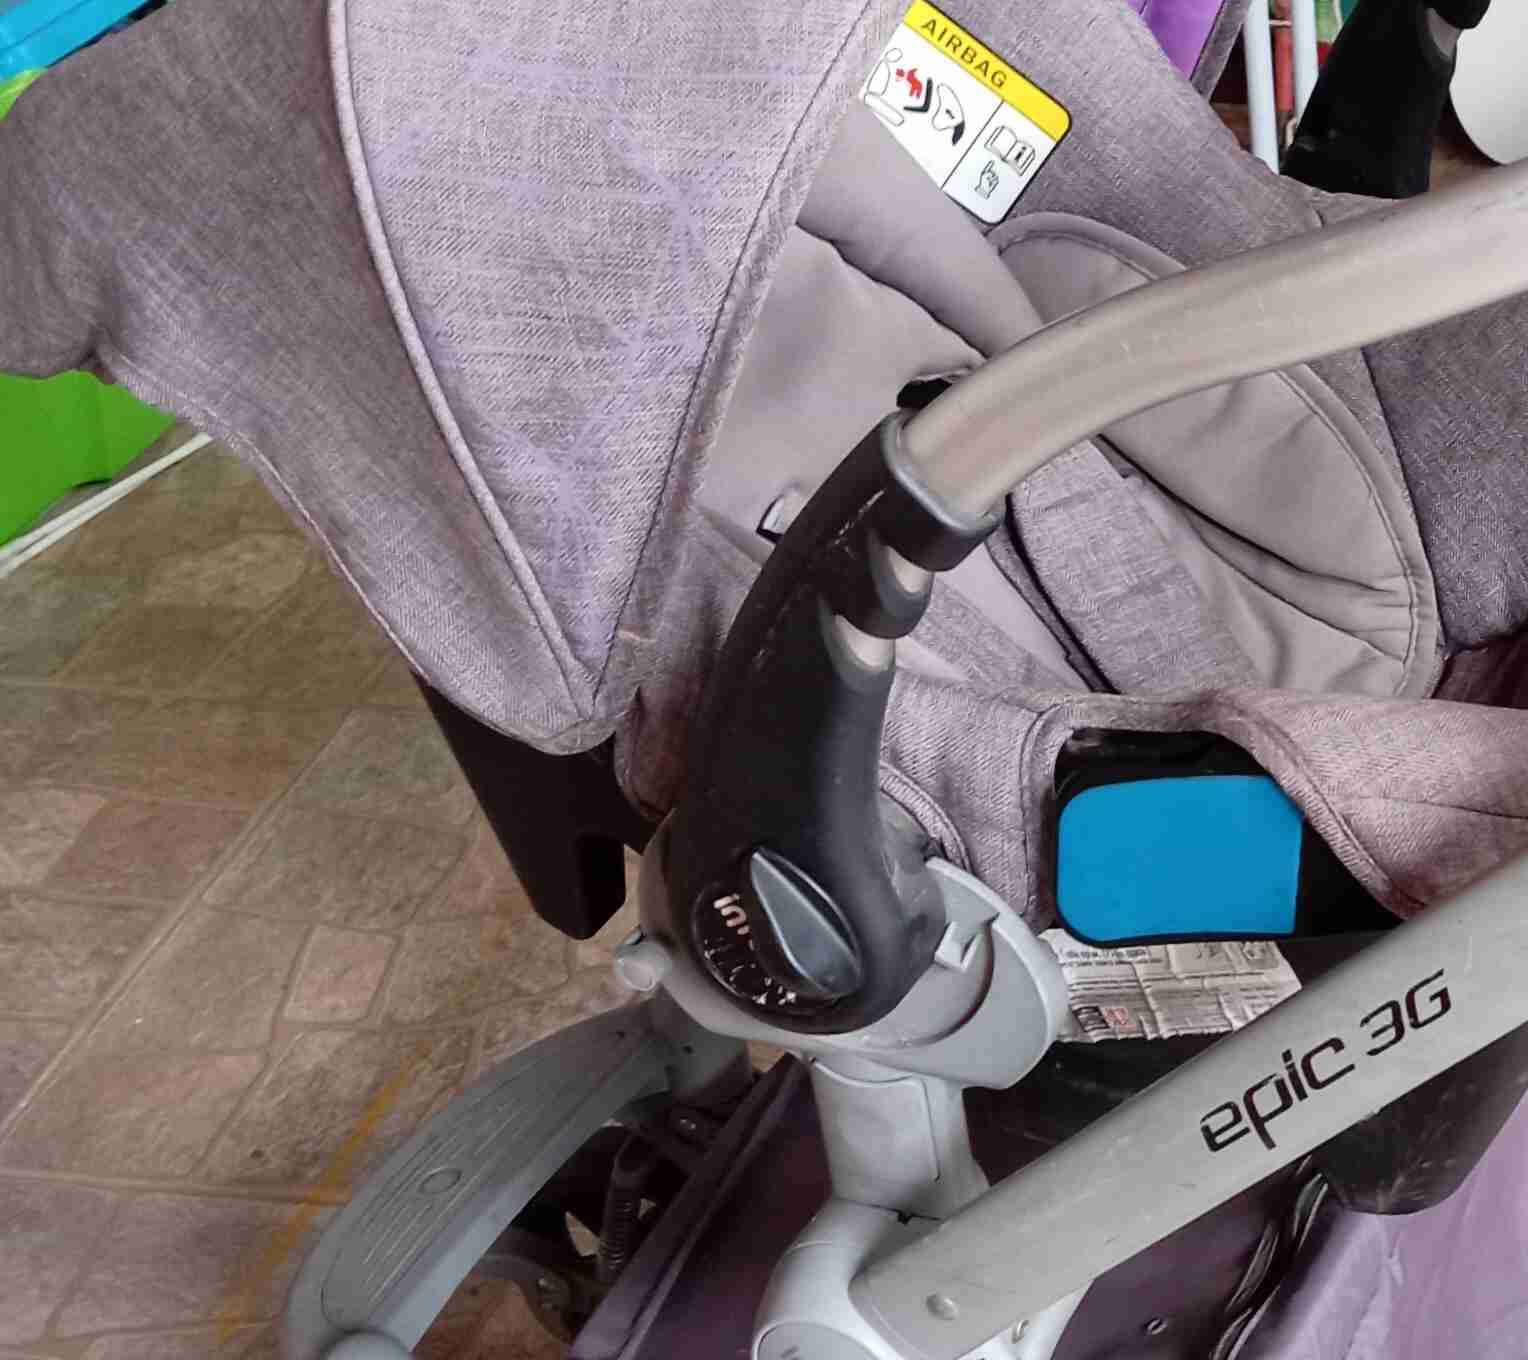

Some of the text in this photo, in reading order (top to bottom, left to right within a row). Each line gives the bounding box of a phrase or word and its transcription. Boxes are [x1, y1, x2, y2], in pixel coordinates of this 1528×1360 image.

[921, 18, 1008, 89] AIRBAG
[1200, 1037, 1356, 1152] epic
[1359, 968, 1452, 1057] 3G
